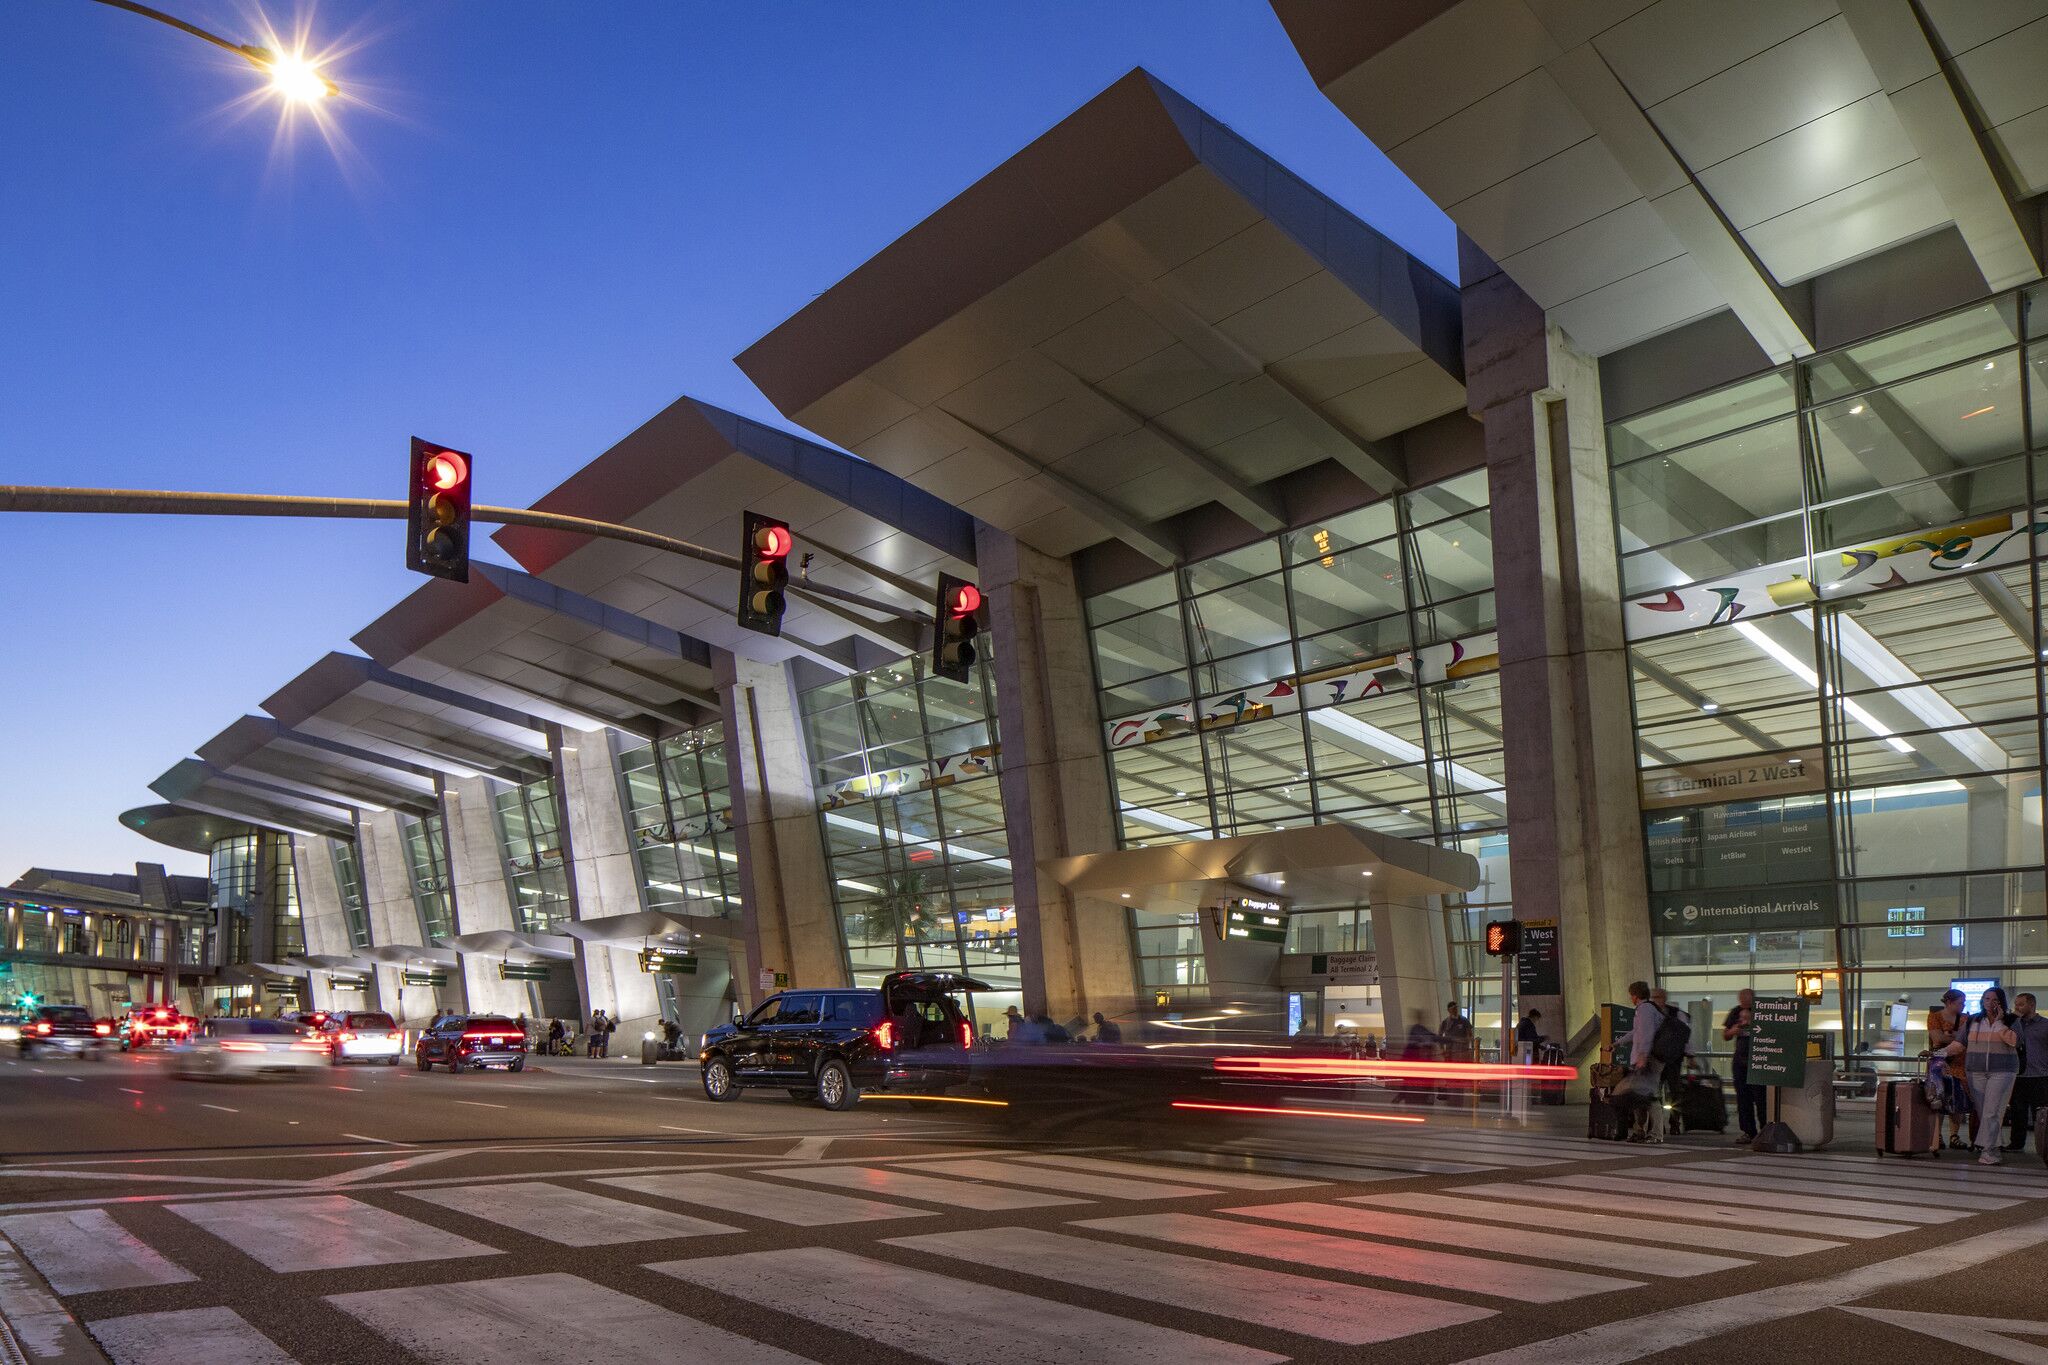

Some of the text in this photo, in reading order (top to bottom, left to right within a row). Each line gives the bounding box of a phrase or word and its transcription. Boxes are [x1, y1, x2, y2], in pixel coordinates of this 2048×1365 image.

[1675, 763, 1806, 792] Terminal 2 West
[1782, 824, 1808, 833] United
[1671, 835, 1699, 846] Airways
[1707, 830, 1757, 842] Japan Airlines
[1781, 845, 1812, 855] WestJet
[1665, 857, 1684, 865] Delta
[1720, 852, 1747, 861] JetBlue
[1700, 899, 1820, 917] International Arrivals
[1530, 929, 1554, 939] West
[1330, 954, 1376, 965] Baggage Claim
[1340, 965, 1367, 973] Terminal
[1754, 1001, 1798, 1010] Terminal 1
[1754, 1012, 1797, 1022] First Level
[1753, 1036, 1777, 1044] Frontier
[1752, 1045, 1783, 1054] Southwest
[1751, 1054, 1768, 1062] Spirit
[1763, 1063, 1787, 1073] Country
